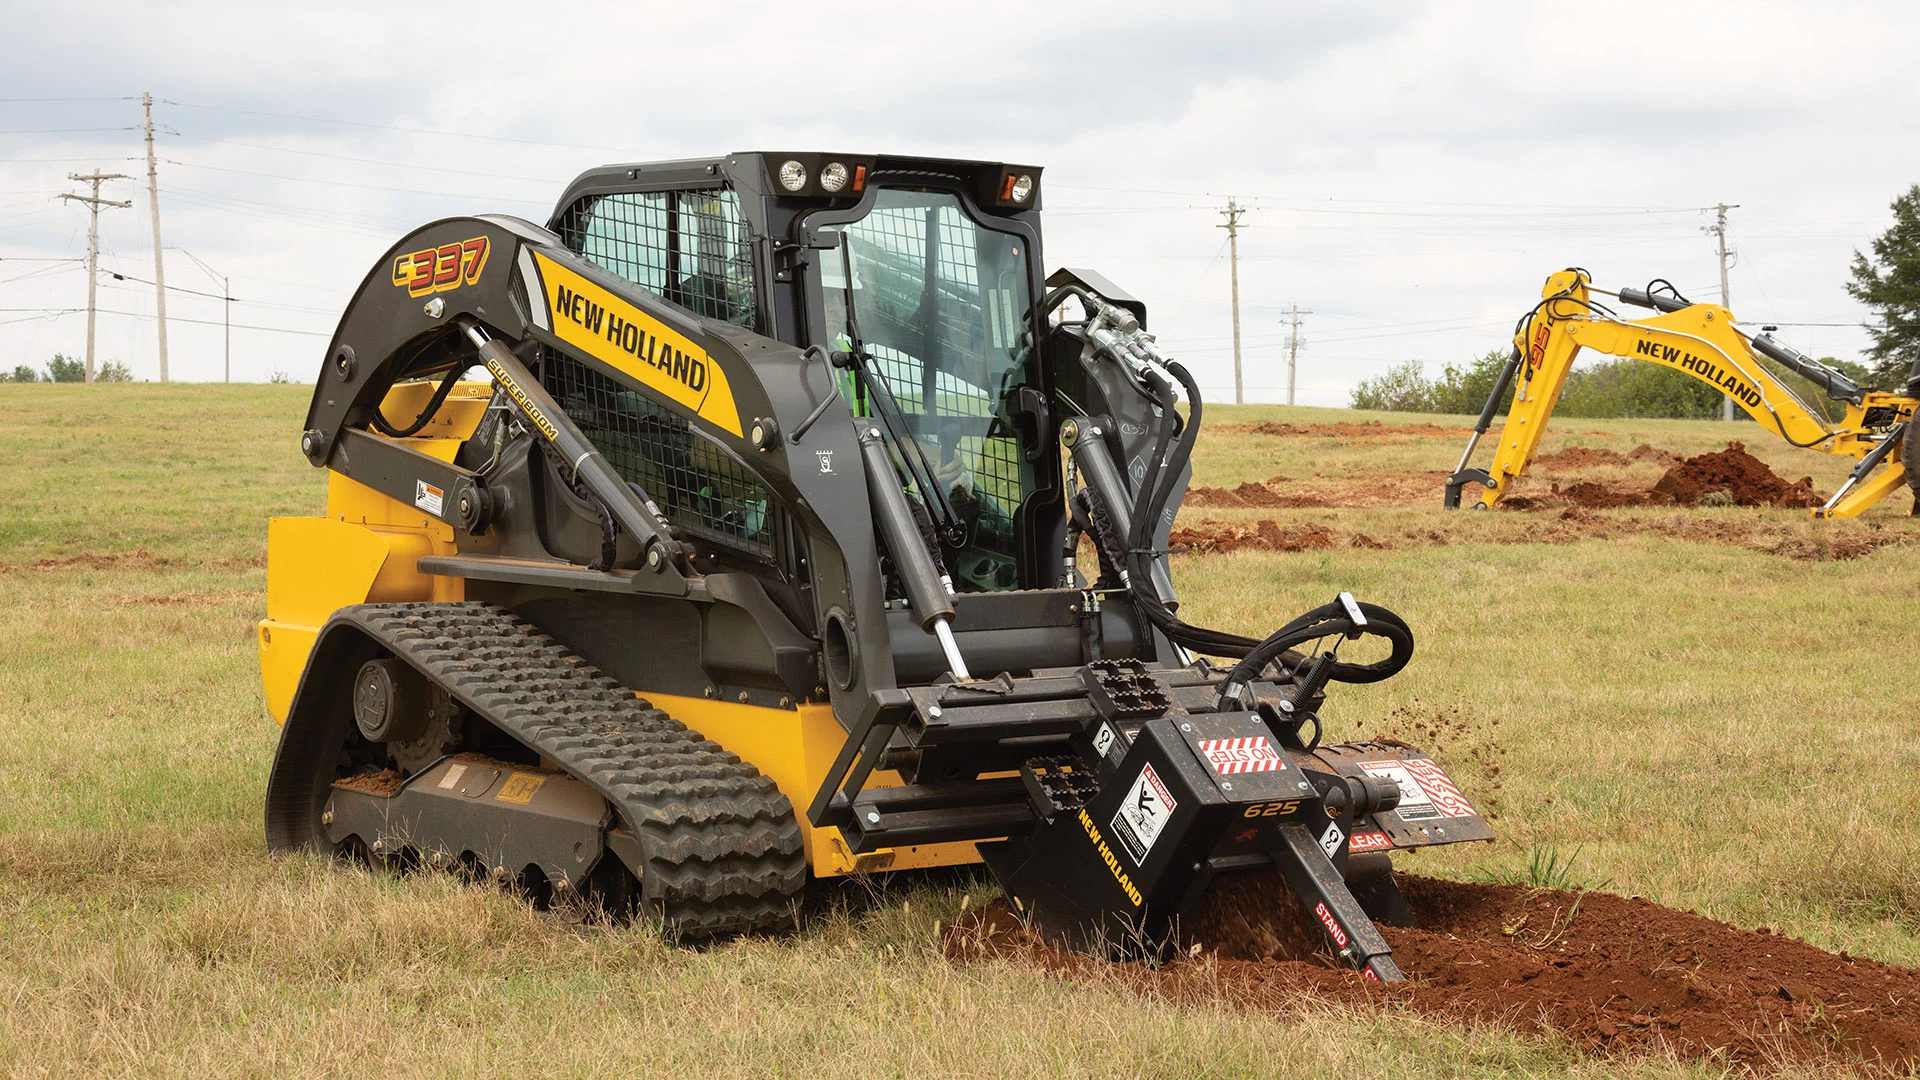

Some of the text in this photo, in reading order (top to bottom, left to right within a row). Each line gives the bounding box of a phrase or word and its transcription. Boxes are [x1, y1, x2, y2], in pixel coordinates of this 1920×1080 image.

[393, 236, 489, 297] C337
[556, 284, 706, 392] NEW HOLLAND
[1636, 339, 1762, 408] NEW HOLLAND
[1210, 748, 1277, 763] NO STEP
[1151, 777, 1173, 810] DANGER
[1412, 761, 1446, 793] STEP
[1243, 801, 1300, 818] 625
[1443, 796, 1465, 815] NO
[1078, 808, 1101, 845] NEW
[1098, 840, 1143, 907] HOLLAND
[1349, 834, 1388, 849] LEAR
[1316, 903, 1346, 946] STAND
